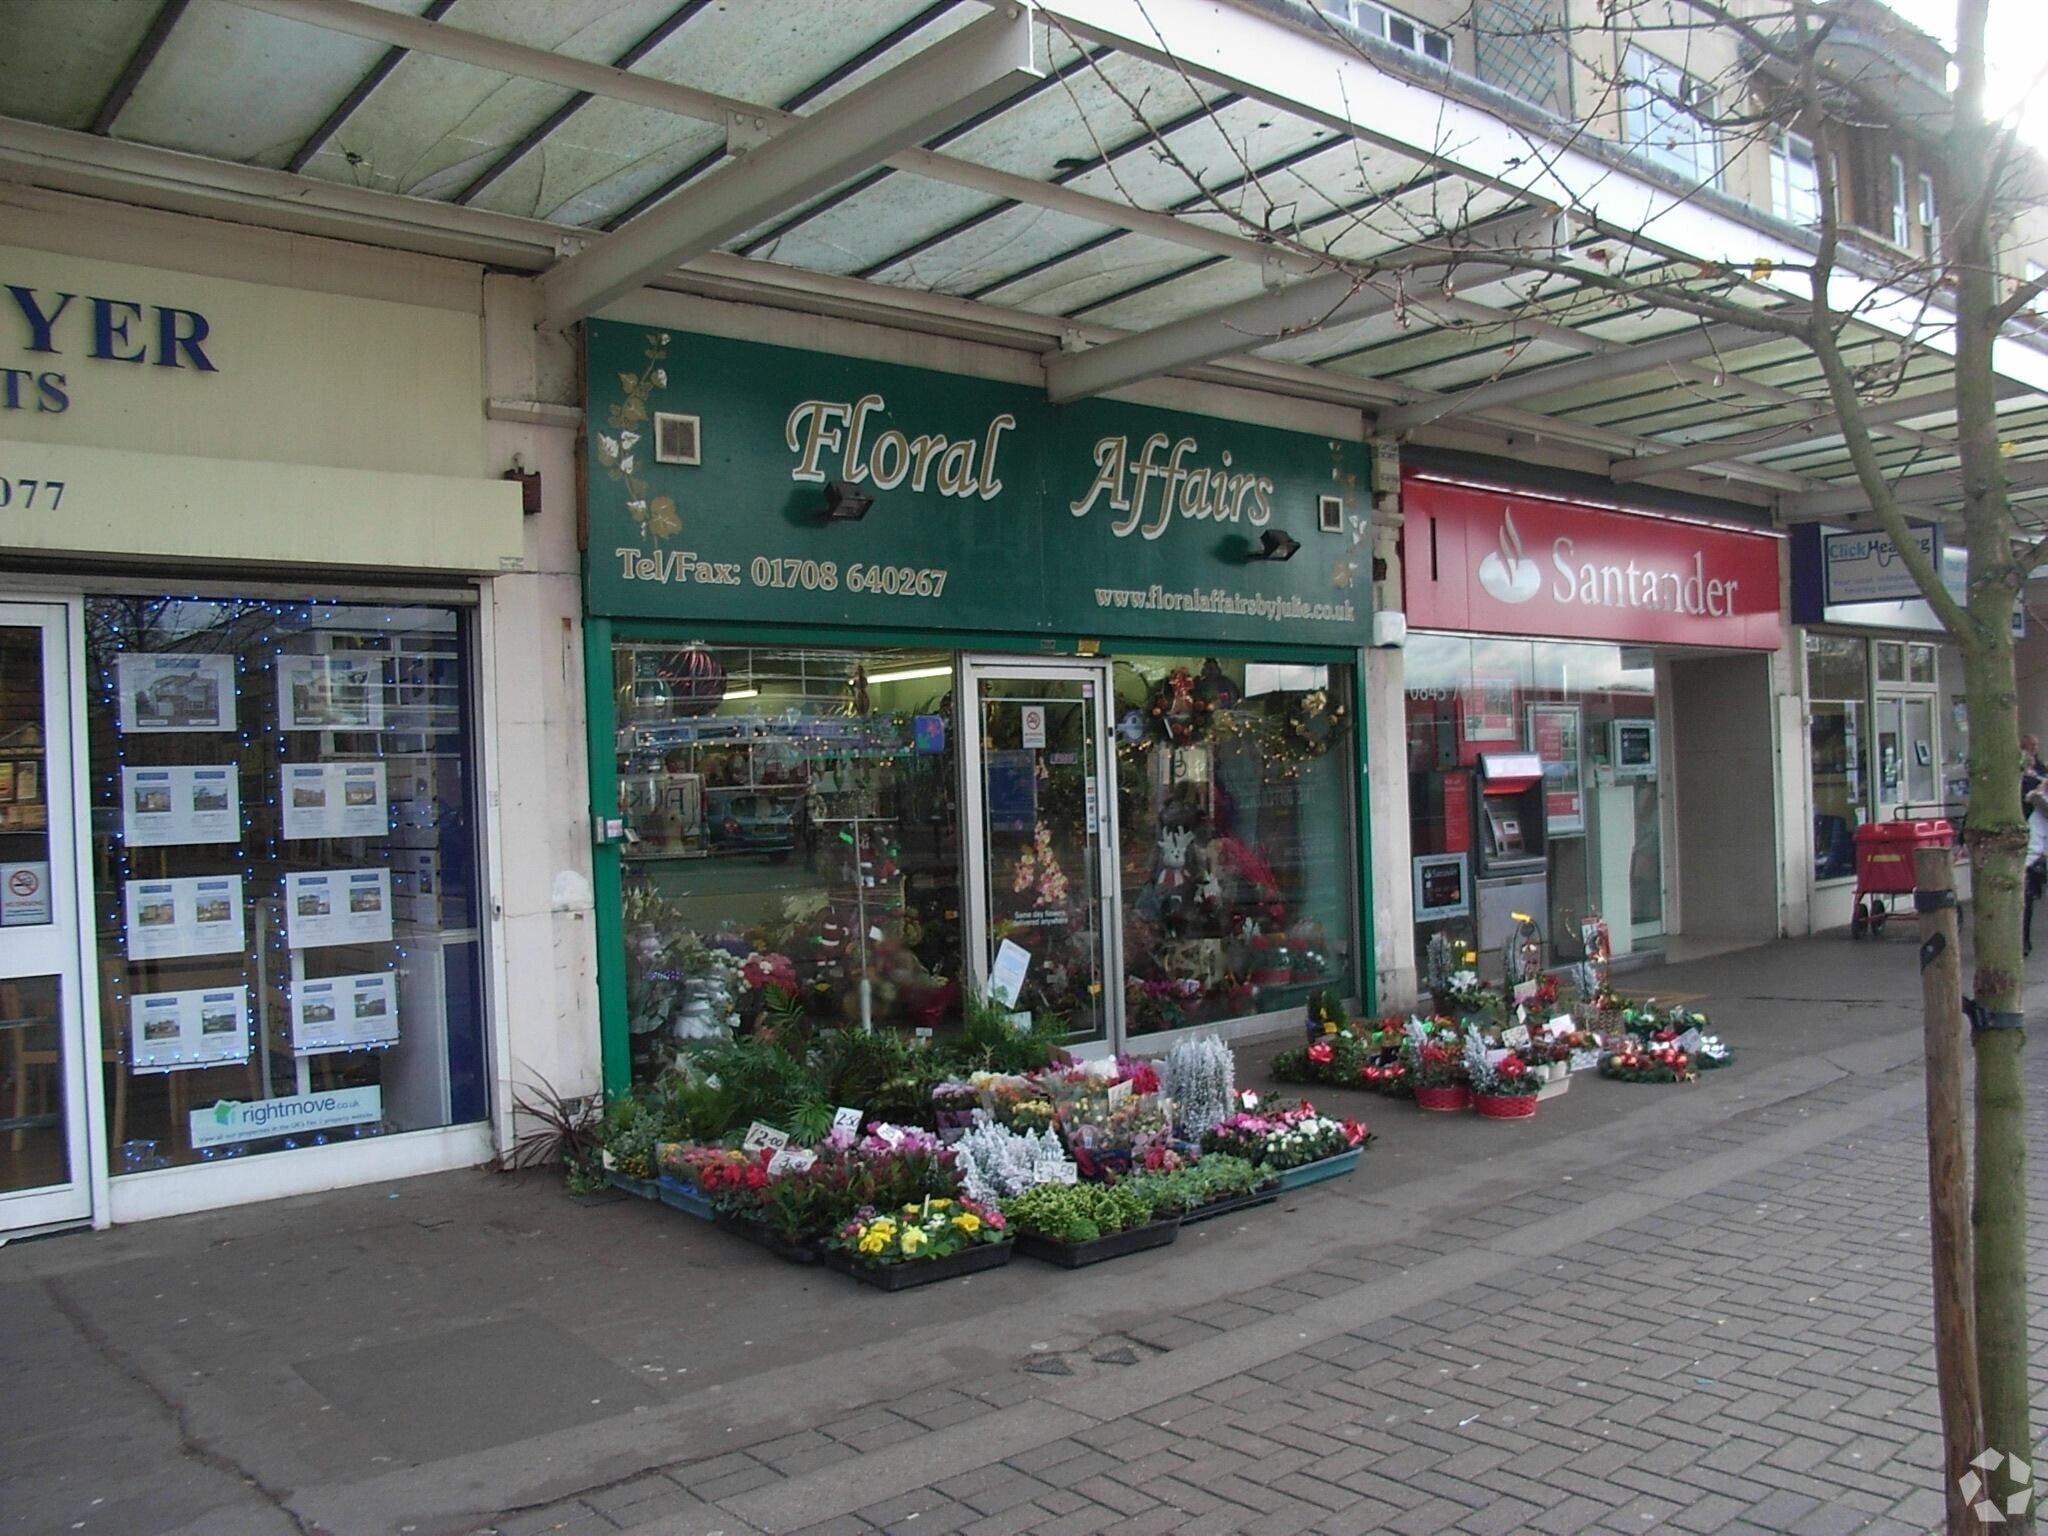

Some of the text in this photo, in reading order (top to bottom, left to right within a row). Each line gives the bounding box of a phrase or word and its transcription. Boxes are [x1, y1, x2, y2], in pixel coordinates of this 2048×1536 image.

[785, 394, 1274, 540] Floral Affairs
[616, 547, 948, 598] Tel/Fax: 01708 640267
[1094, 585, 1355, 622] www.floralaffairsbyjulie.co.uk
[1552, 537, 1738, 616] Santander
